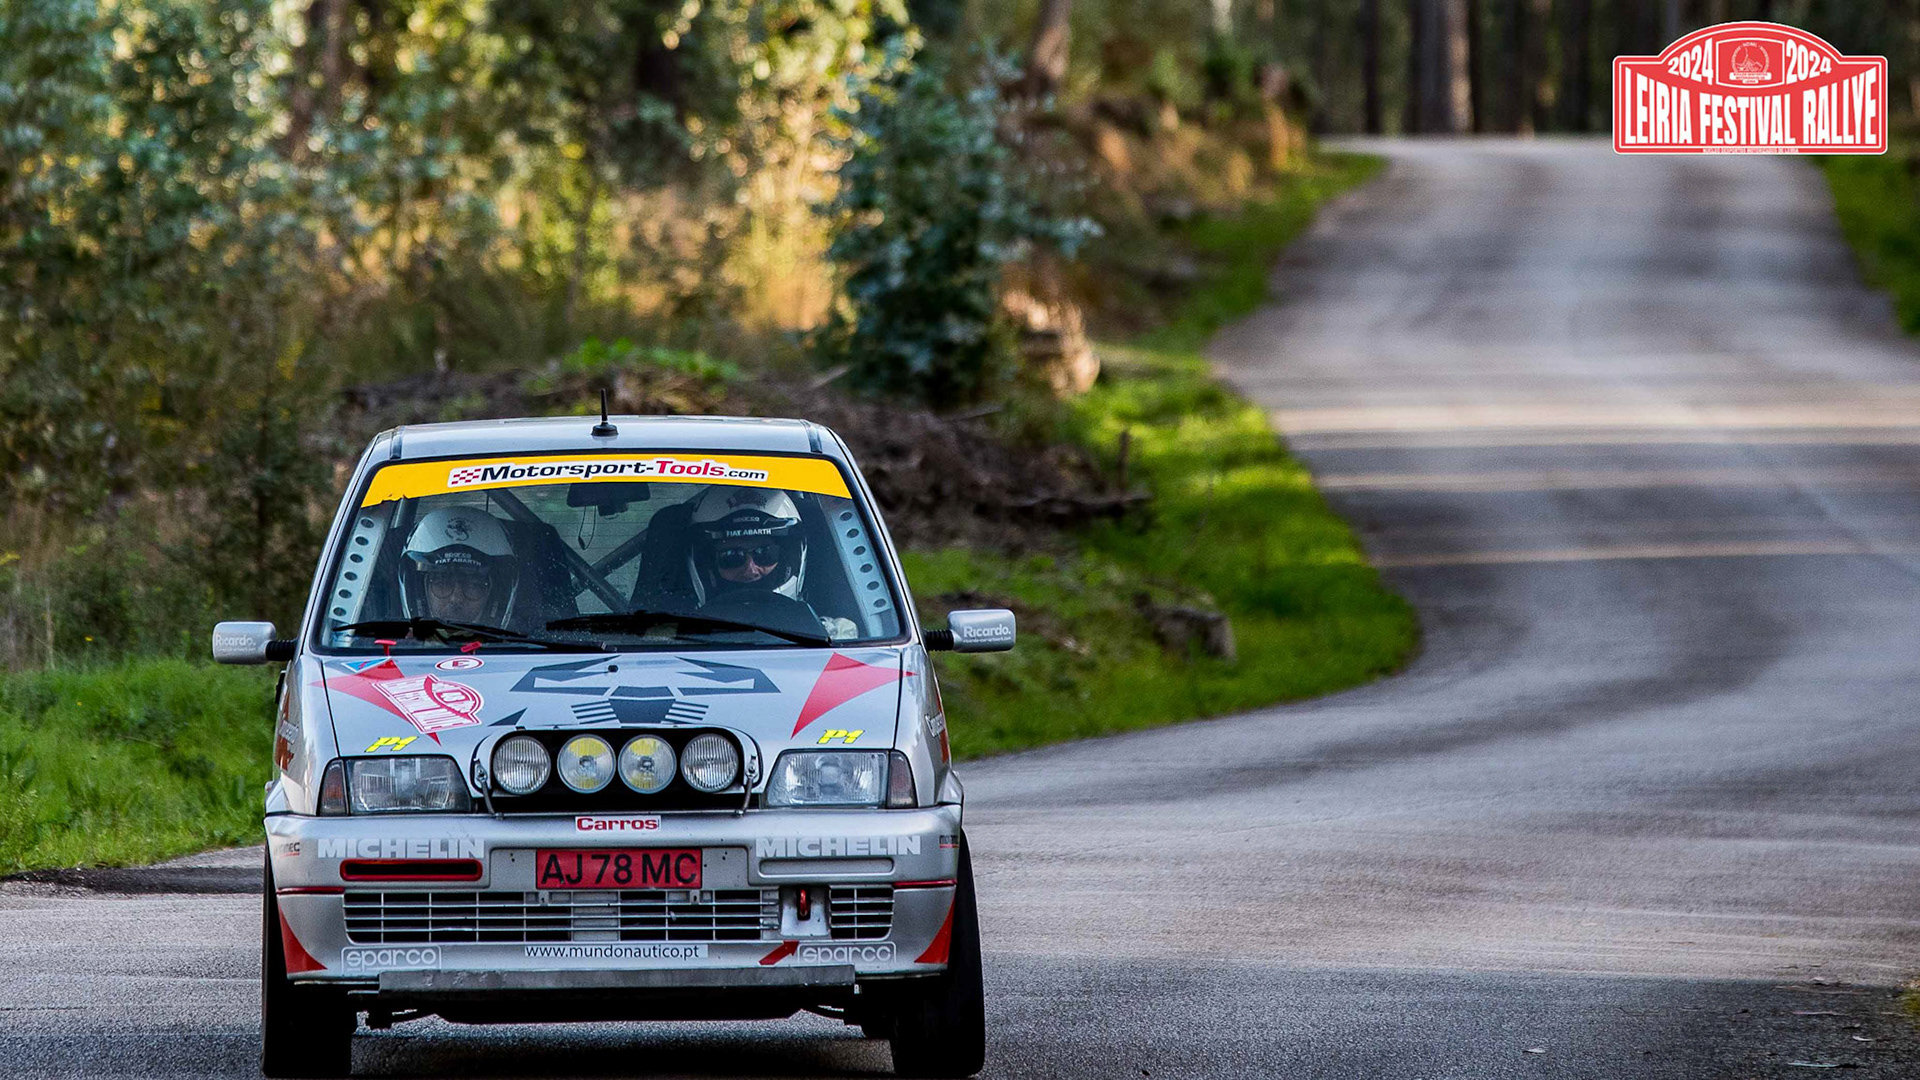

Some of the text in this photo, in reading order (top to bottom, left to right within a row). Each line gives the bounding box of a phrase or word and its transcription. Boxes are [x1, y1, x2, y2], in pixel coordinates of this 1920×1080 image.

[481, 460, 766, 482] Motorsport-Tools.com
[743, 528, 772, 536] ABARTH
[576, 817, 660, 831] Carros
[317, 838, 485, 859] MICHELIN
[756, 835, 922, 858] MICHELIN
[540, 853, 698, 885] AJ 78 MC
[346, 948, 437, 972] sparco
[525, 944, 700, 961] www.mundonautico.pt
